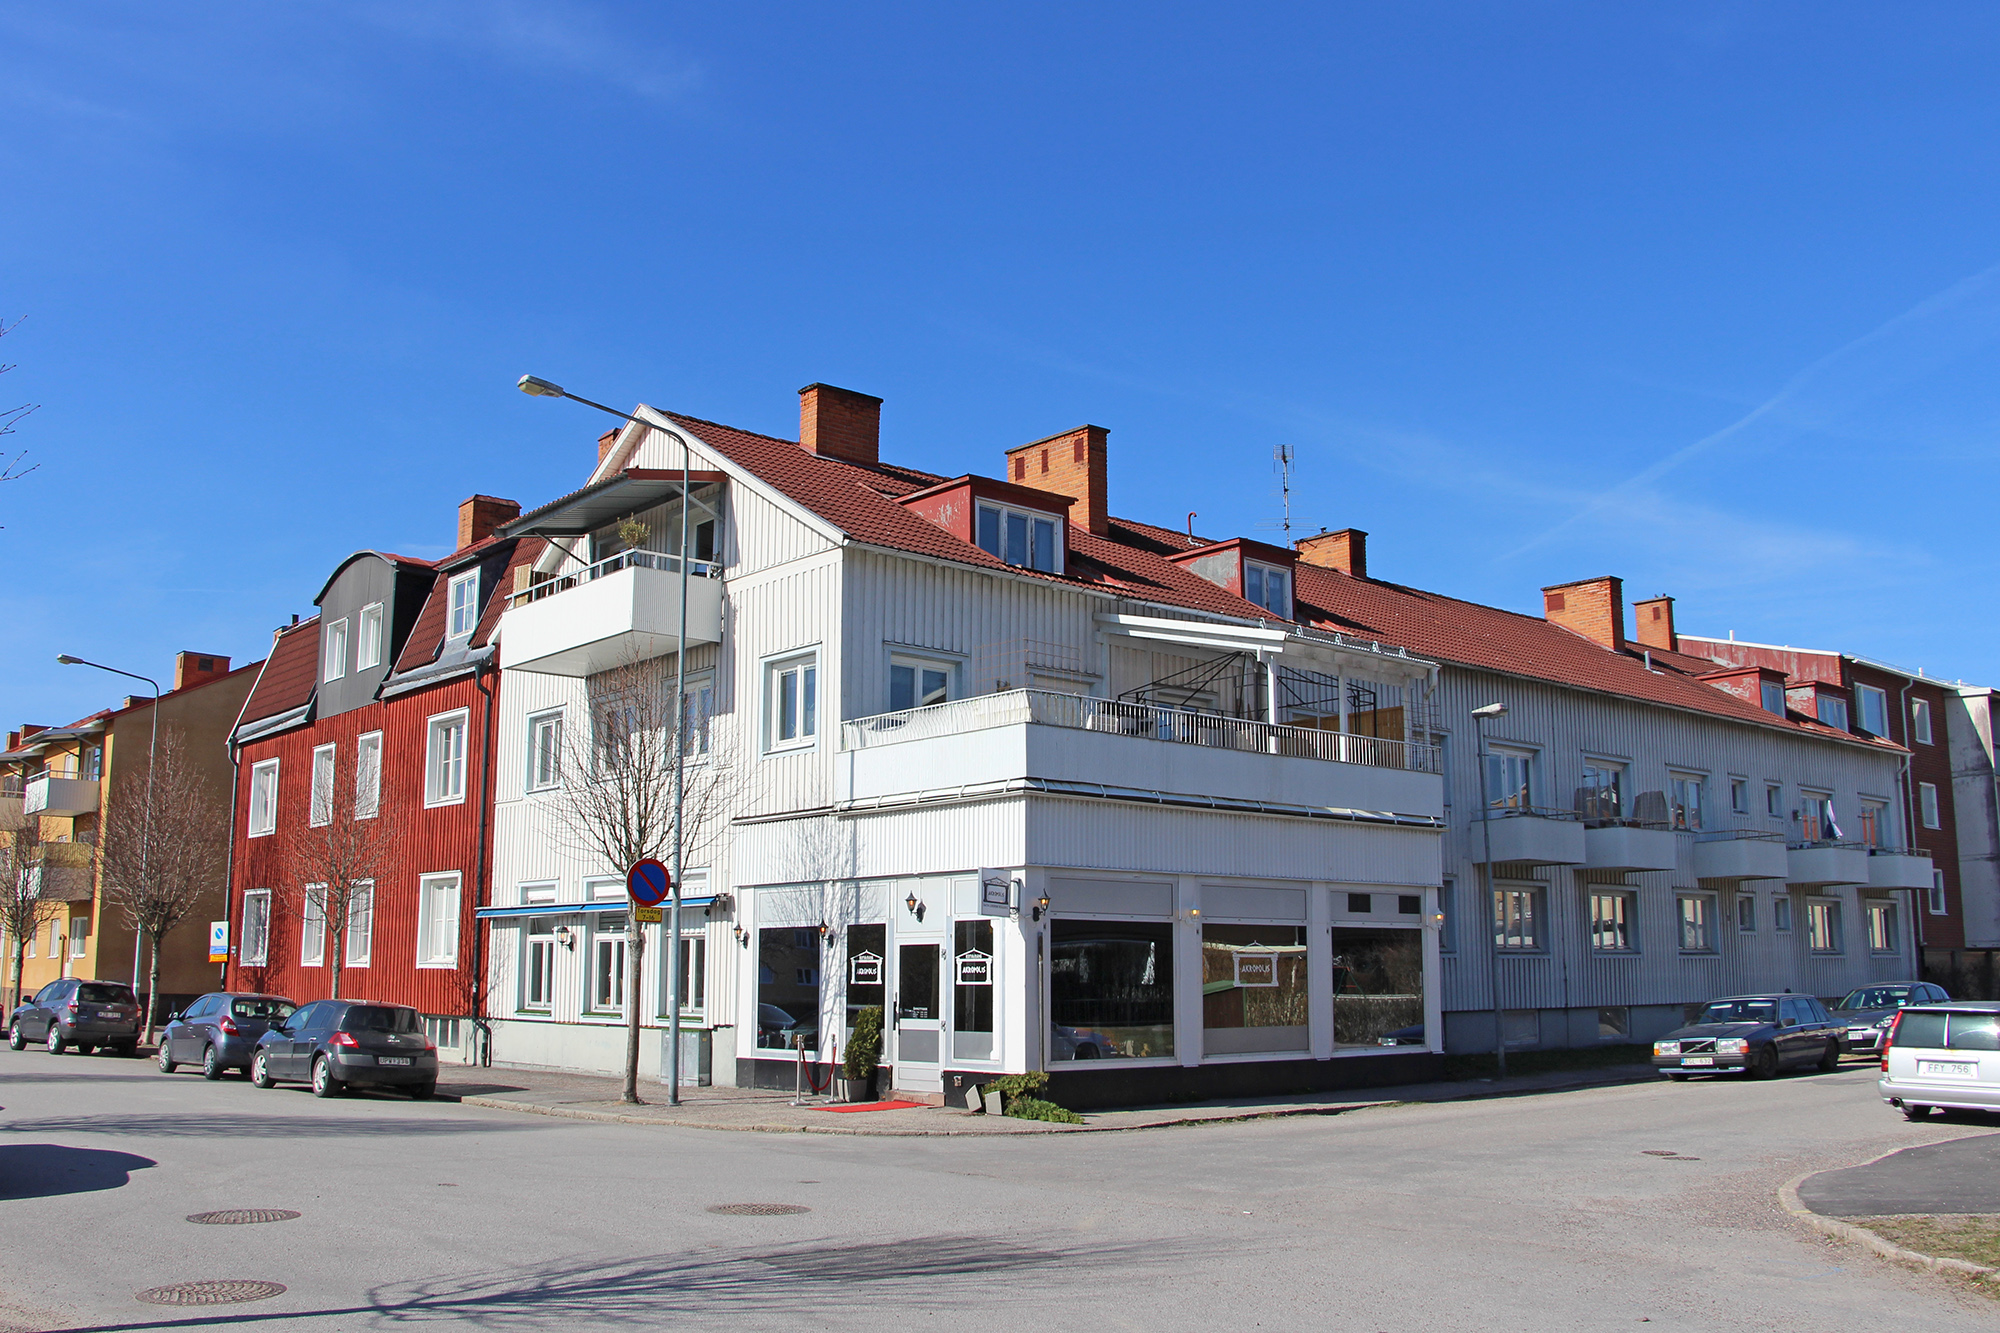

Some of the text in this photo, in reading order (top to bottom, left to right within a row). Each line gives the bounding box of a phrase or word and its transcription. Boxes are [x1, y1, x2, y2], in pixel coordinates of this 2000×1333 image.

[638, 908, 660, 916] Torsdag
[962, 966, 986, 974] AKROPOLIS
[1241, 964, 1271, 973] AKROPOLIS
[1928, 1063, 1969, 1073] FFY 756
